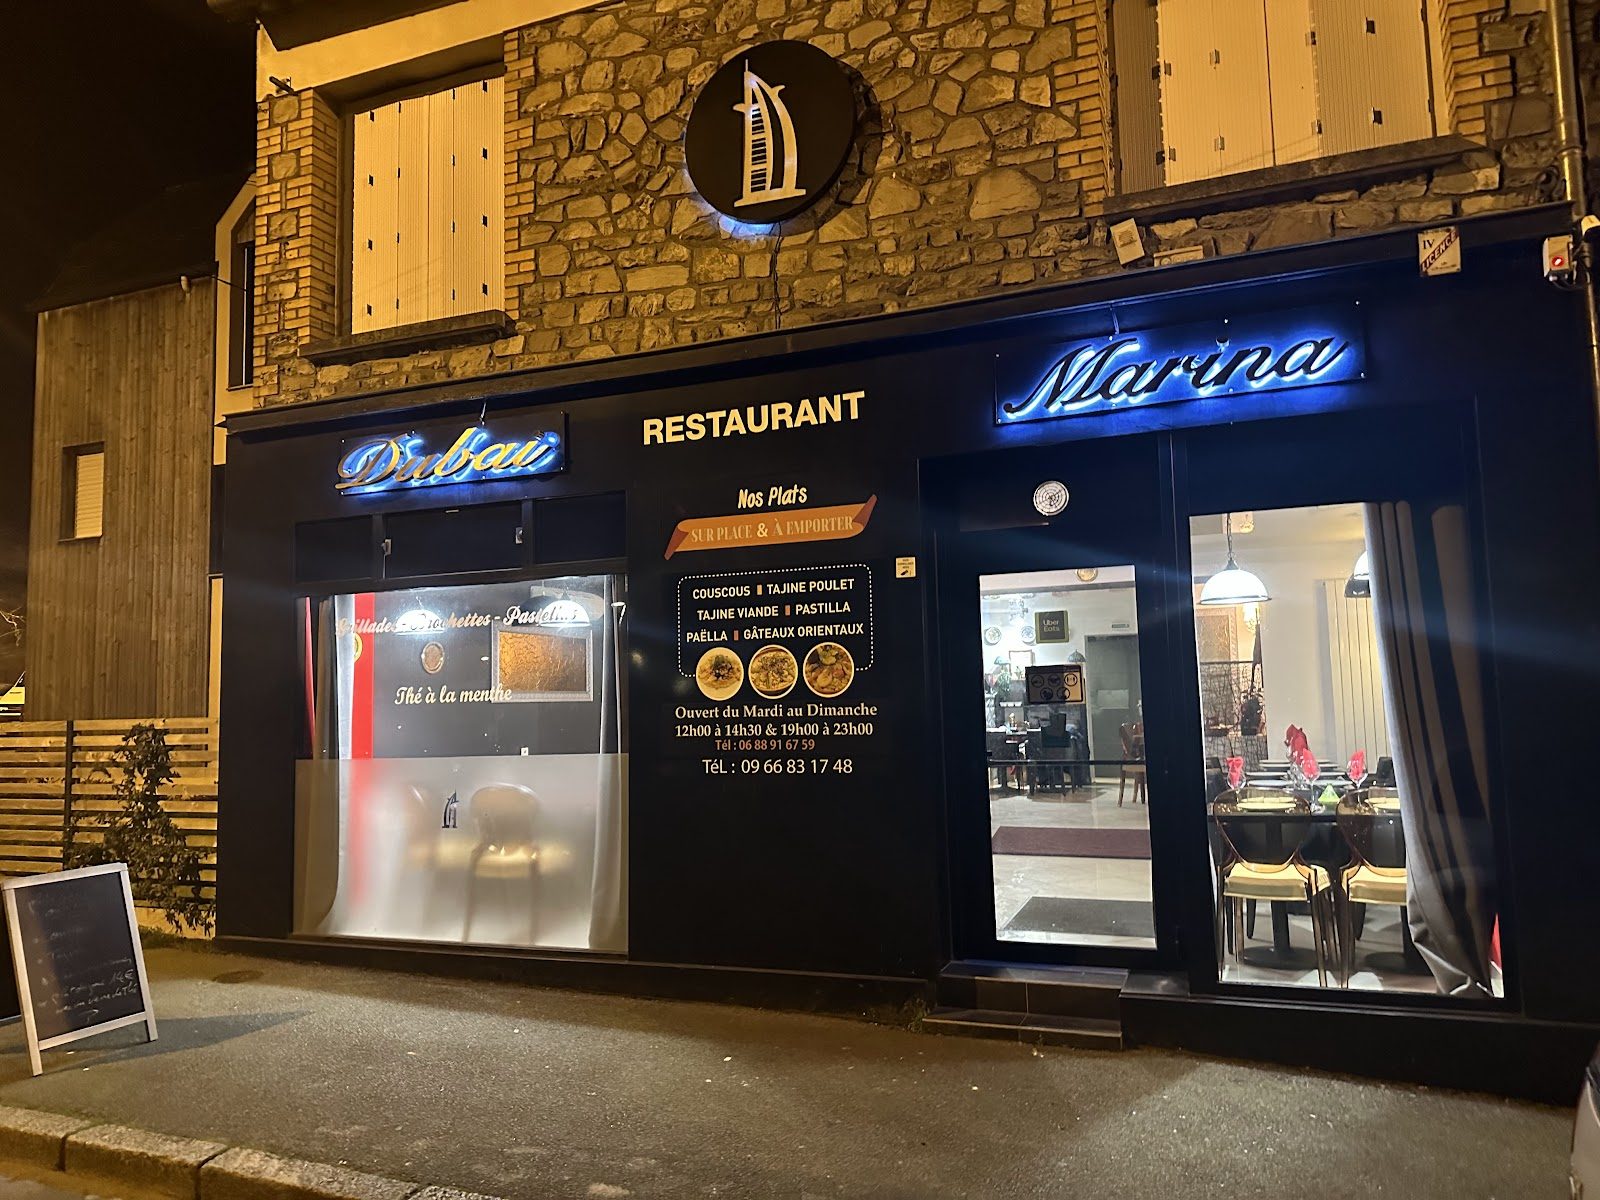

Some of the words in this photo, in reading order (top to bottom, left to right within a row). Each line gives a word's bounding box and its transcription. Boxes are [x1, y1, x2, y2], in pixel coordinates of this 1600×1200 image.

[1421, 230, 1457, 272] LICENCE
[1422, 239, 1435, 249] IV
[1003, 335, 1348, 414] Marina
[643, 390, 866, 446] RESTAURANT
[335, 427, 559, 490] Dubai
[737, 488, 764, 509] Nos
[767, 484, 808, 507] Plats
[691, 526, 715, 543] SUR
[716, 524, 752, 541] PLACE
[756, 523, 769, 537] &
[772, 518, 784, 536] À
[786, 516, 854, 535] EMPORTER
[692, 585, 751, 600] COUSCOUS
[766, 581, 807, 595] TAJINE
[809, 578, 855, 593] POULET
[697, 608, 735, 621] TAJINE
[737, 605, 779, 618] VIANDE
[795, 601, 851, 615] PASTILLA
[686, 628, 728, 642] PAËLLA
[743, 625, 795, 640] GÂTEAUX
[797, 623, 864, 637] ORIENTAUX
[394, 685, 423, 705] Thé
[425, 685, 436, 702] à
[439, 687, 457, 702] la
[459, 685, 513, 704] menthe
[675, 706, 720, 719] Ouvert
[722, 705, 740, 718] du
[743, 703, 784, 717] Mardi
[786, 707, 803, 717] au
[806, 702, 878, 717] Dimanche
[675, 724, 712, 737] 12h00
[714, 724, 722, 737] à
[724, 724, 762, 736] 14h30
[765, 724, 778, 736] &
[780, 723, 819, 736] 19h00
[822, 722, 830, 735] à
[833, 722, 874, 735] 23h00
[715, 739, 731, 751] Tél
[738, 739, 753, 751] 06
[754, 739, 768, 751] 88
[769, 739, 783, 751] 91
[785, 739, 799, 751] 67
[801, 739, 816, 751] 59
[702, 759, 728, 774] TéL
[741, 759, 760, 774] 09
[763, 759, 783, 774] 66
[786, 759, 805, 774] 83
[811, 759, 829, 774] 17
[833, 759, 853, 774] 48
